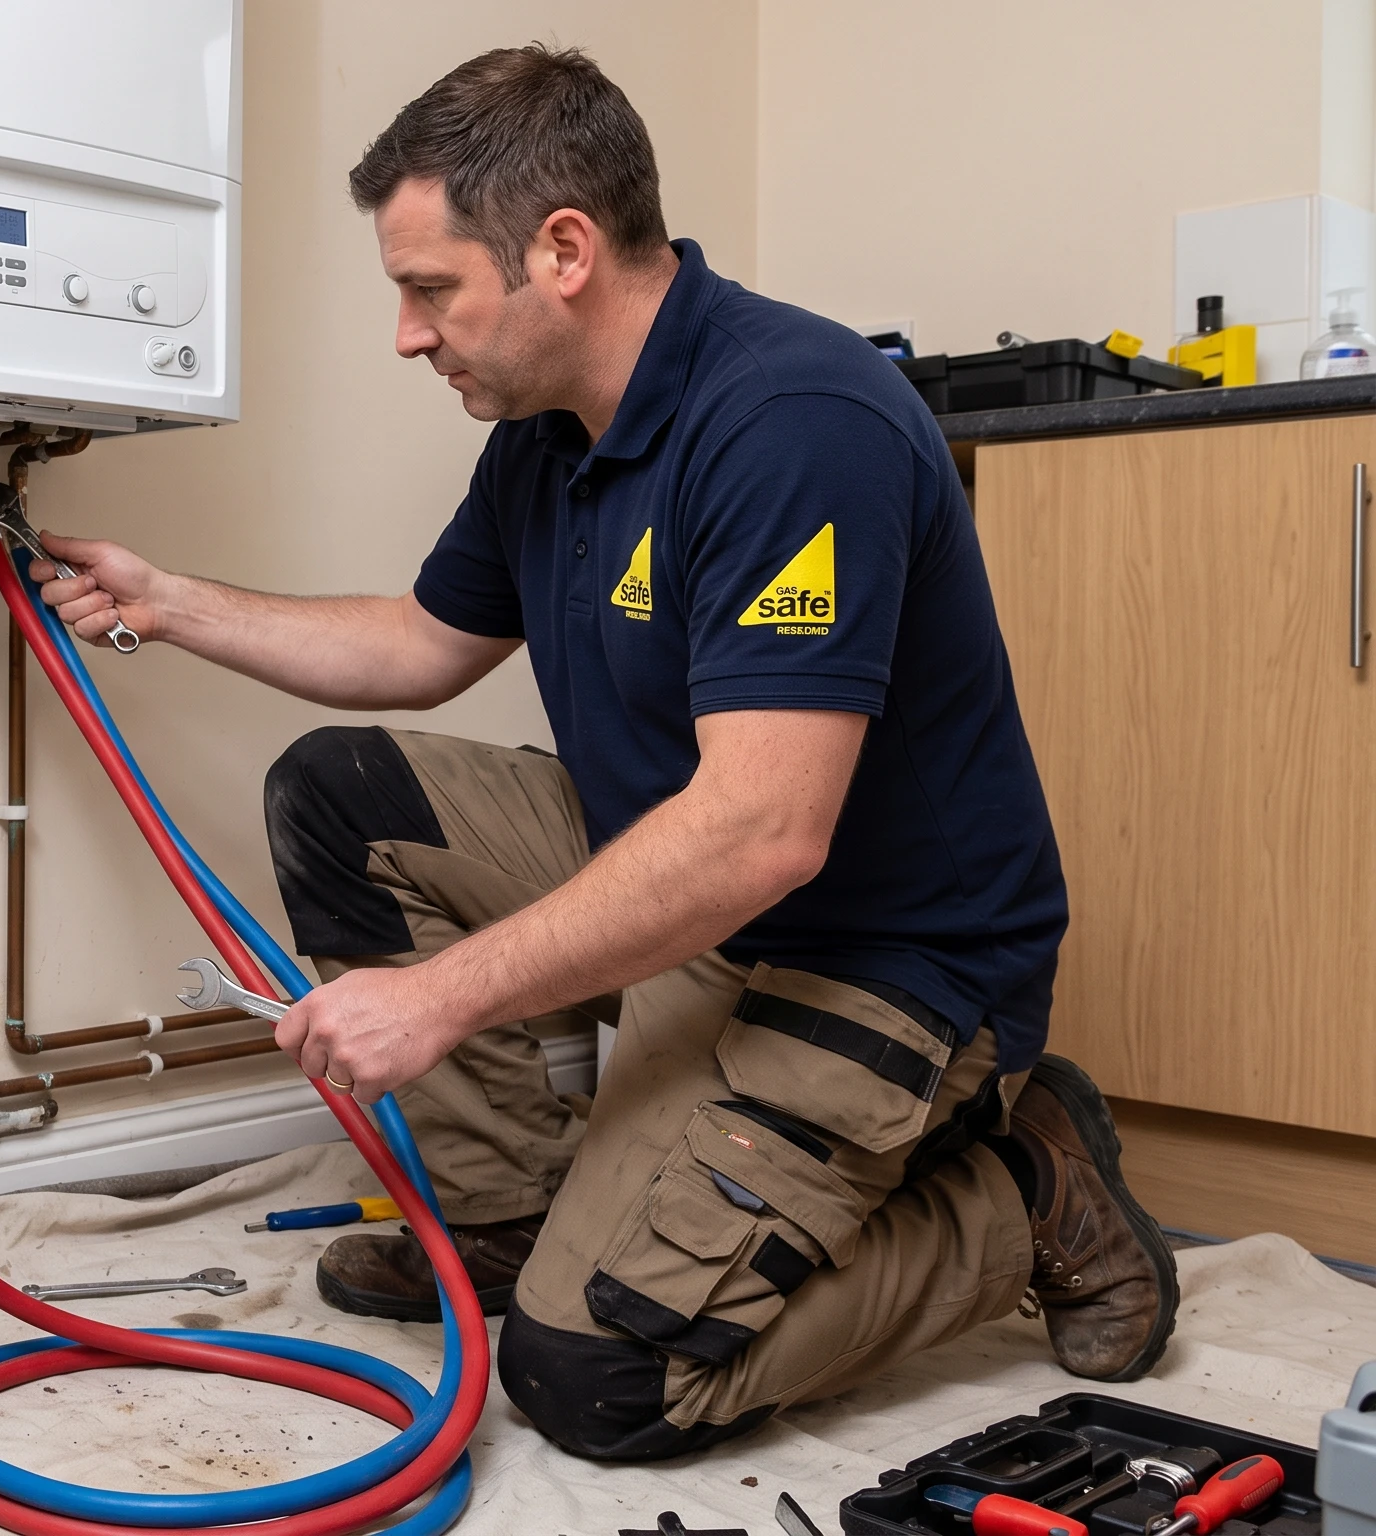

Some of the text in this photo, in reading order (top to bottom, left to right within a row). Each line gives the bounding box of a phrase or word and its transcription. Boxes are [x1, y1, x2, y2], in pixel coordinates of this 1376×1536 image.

[620, 581, 650, 605] safe
[776, 587, 798, 596] GAS
[758, 590, 830, 618] safe
